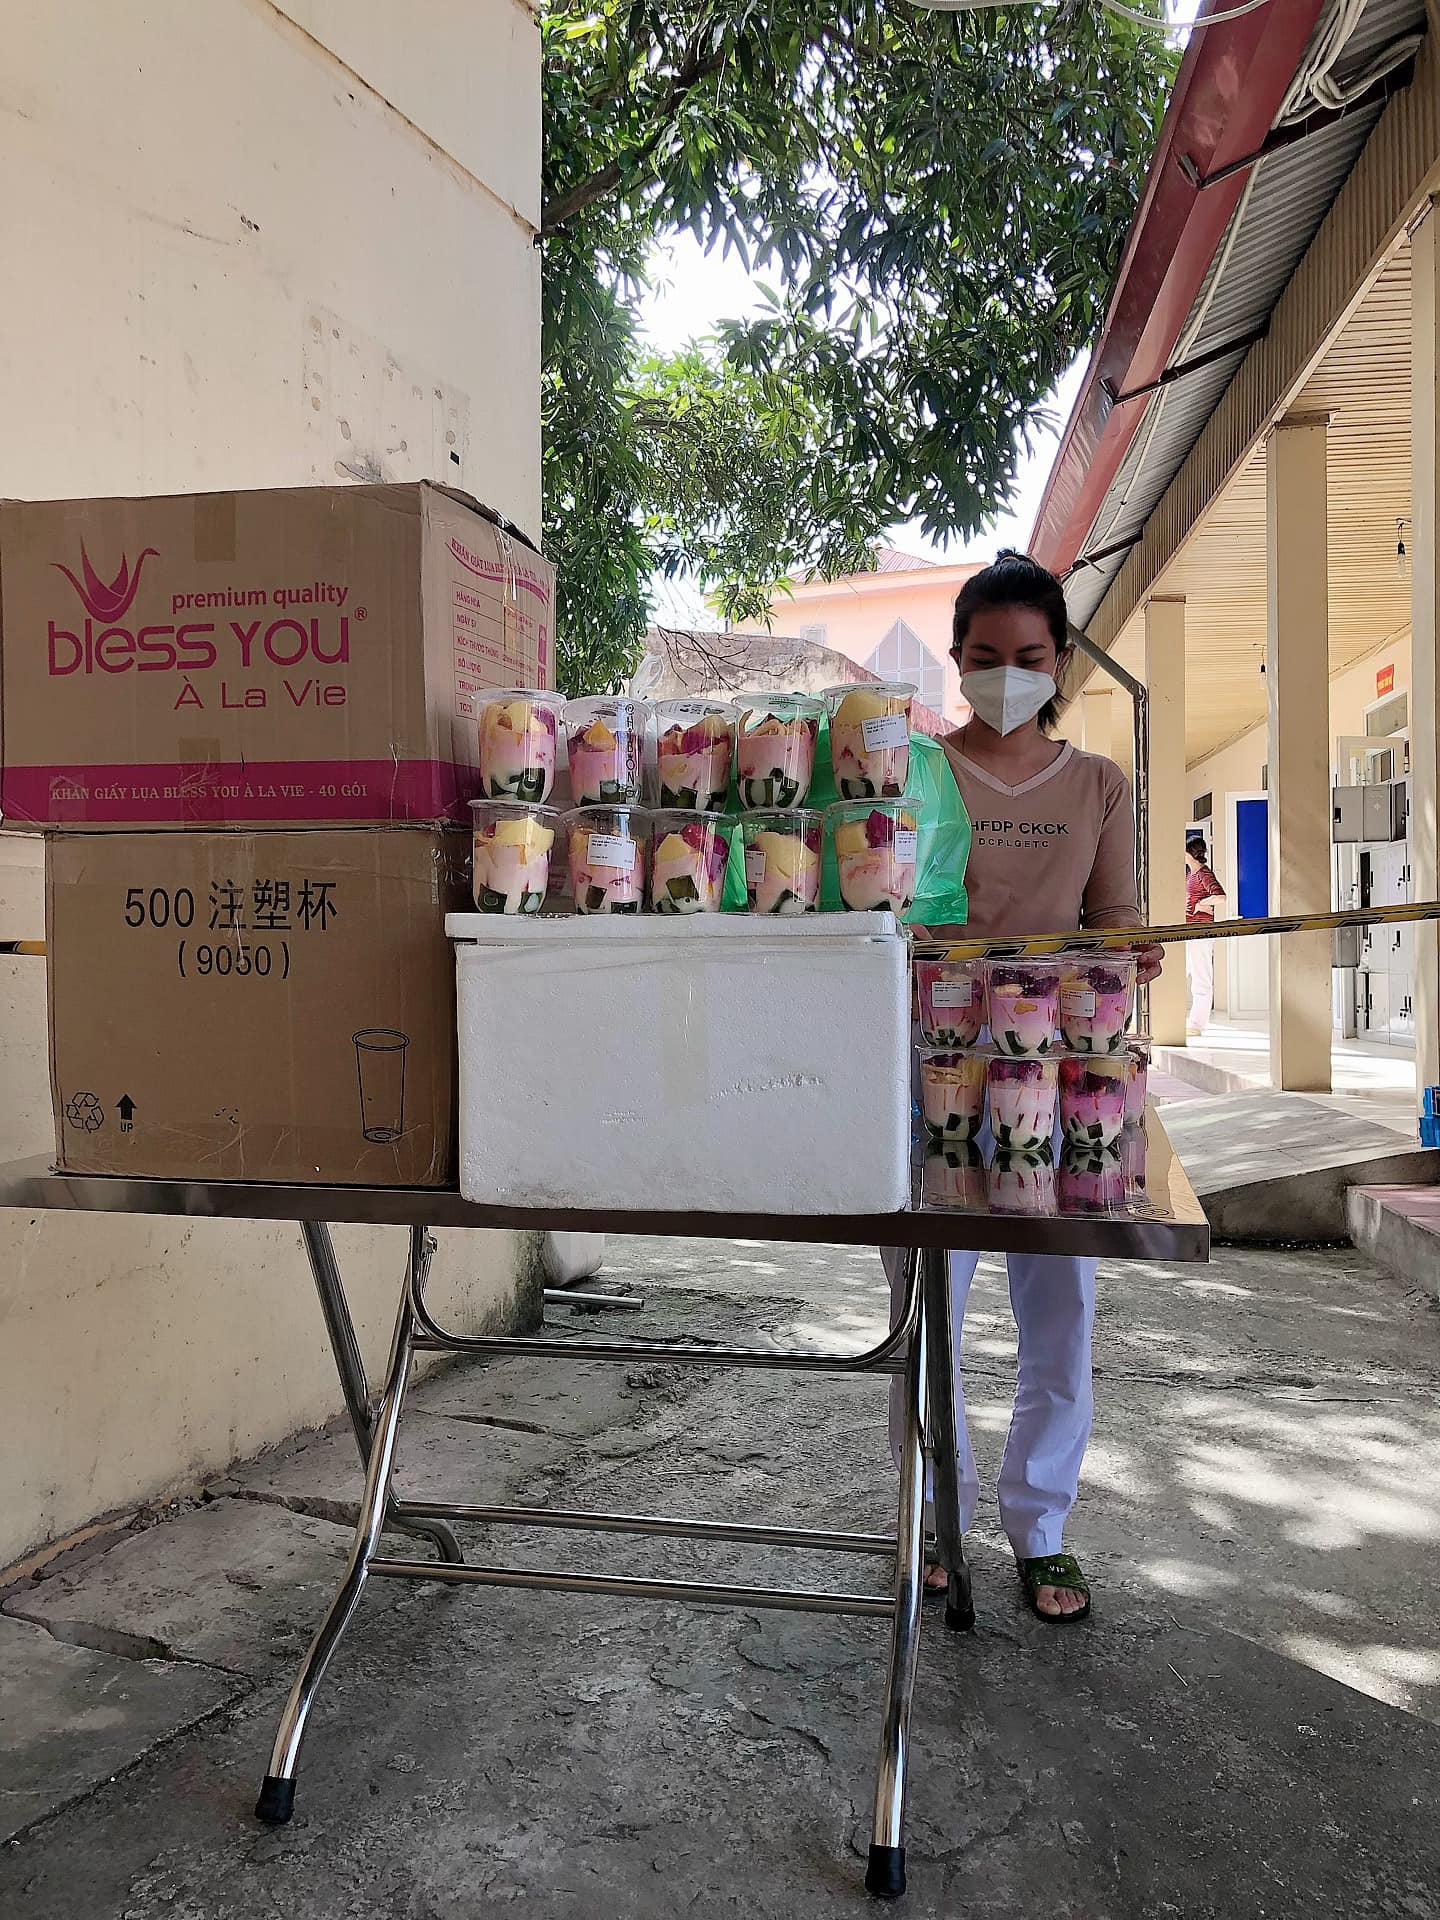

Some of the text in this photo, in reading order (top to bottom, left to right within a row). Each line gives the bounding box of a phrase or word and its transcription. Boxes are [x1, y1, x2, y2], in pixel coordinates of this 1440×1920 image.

[172, 582, 349, 614] premium quality
[48, 618, 217, 676] bless
[174, 675, 347, 710] À La Vie
[94, 782, 128, 800] GIẤY
[131, 787, 160, 802] LỤA
[163, 785, 207, 799] BLESS
[211, 785, 239, 798] YOU
[244, 783, 254, 798] À
[258, 785, 277, 797] LA
[280, 785, 304, 797] VIE
[319, 785, 336, 797] 40
[341, 781, 368, 797] GÓI
[1019, 822, 1069, 835] CKCK
[978, 837, 1049, 848] DCPLGETC
[125, 878, 338, 931] 500 注塑杯
[120, 1122, 134, 1133] UP
